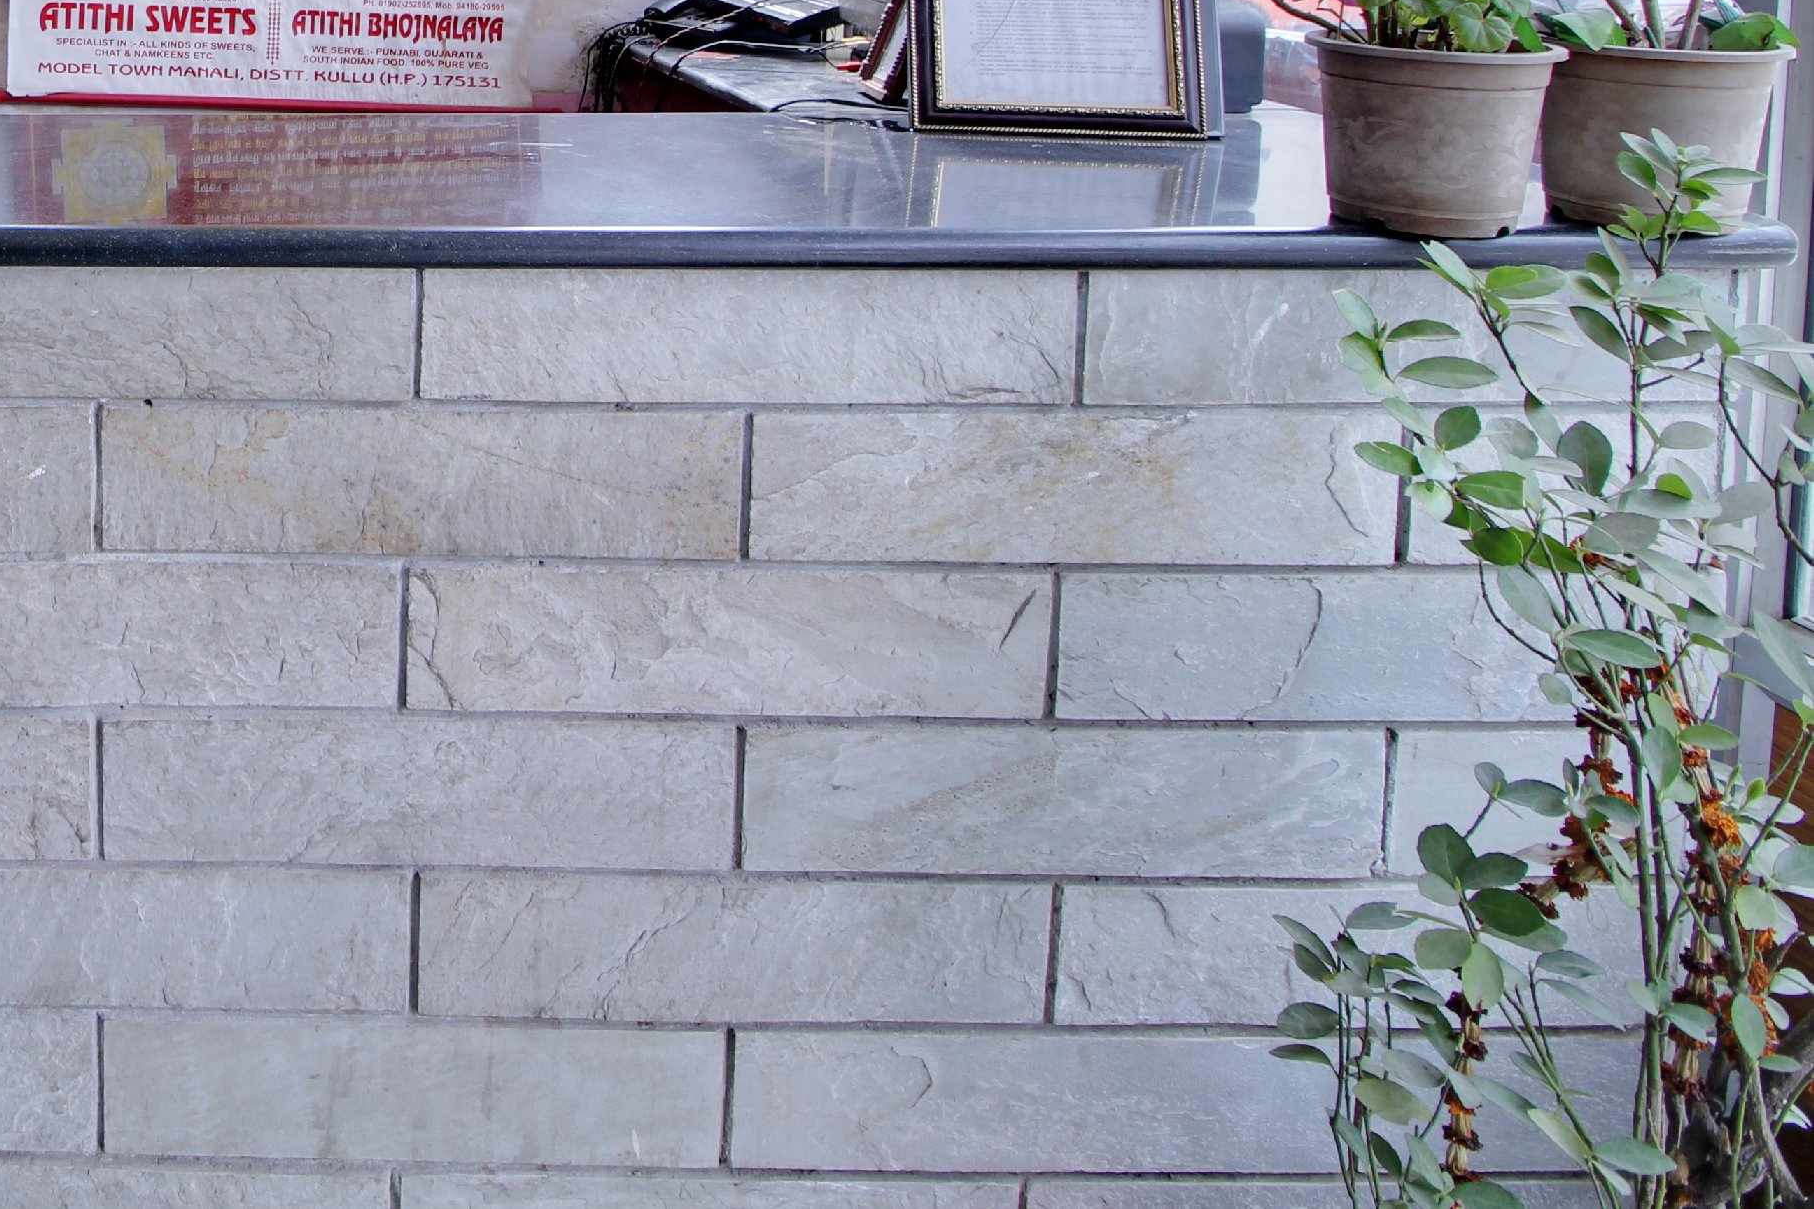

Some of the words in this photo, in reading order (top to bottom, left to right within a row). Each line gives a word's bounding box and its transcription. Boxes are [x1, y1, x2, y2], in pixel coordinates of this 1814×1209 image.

[39, 2, 134, 35] ATITHI
[145, 5, 257, 36] SWEETS
[291, 9, 361, 38] ATITHI
[367, 12, 504, 44] BHOJNALAYA
[56, 37, 115, 47] SPECIALIST
[116, 39, 127, 47] IN
[138, 40, 158, 49] ALL
[160, 40, 191, 50] KINDS
[193, 41, 208, 51] OF
[94, 48, 121, 57] CHAT
[124, 49, 131, 57] &
[134, 49, 190, 59] NAMKEENS
[193, 51, 215, 60] ETC.
[311, 45, 329, 54] WE
[331, 46, 365, 56] SERVE
[424, 49, 474, 59] GUJARATI
[476, 51, 484, 60] &
[303, 55, 337, 65] SOUTH
[340, 56, 374, 66] INDIAN
[411, 58, 435, 68] 100%
[438, 60, 465, 69] PURE
[467, 61, 491, 71] VEG.
[38, 62, 102, 75] MODEL
[108, 63, 163, 77] TOWN
[168, 65, 244, 81] MANALI,
[249, 68, 308, 82] DISTT.
[314, 71, 374, 84] KULLU
[379, 72, 427, 88] (H.P.)
[432, 74, 501, 89] 175131
